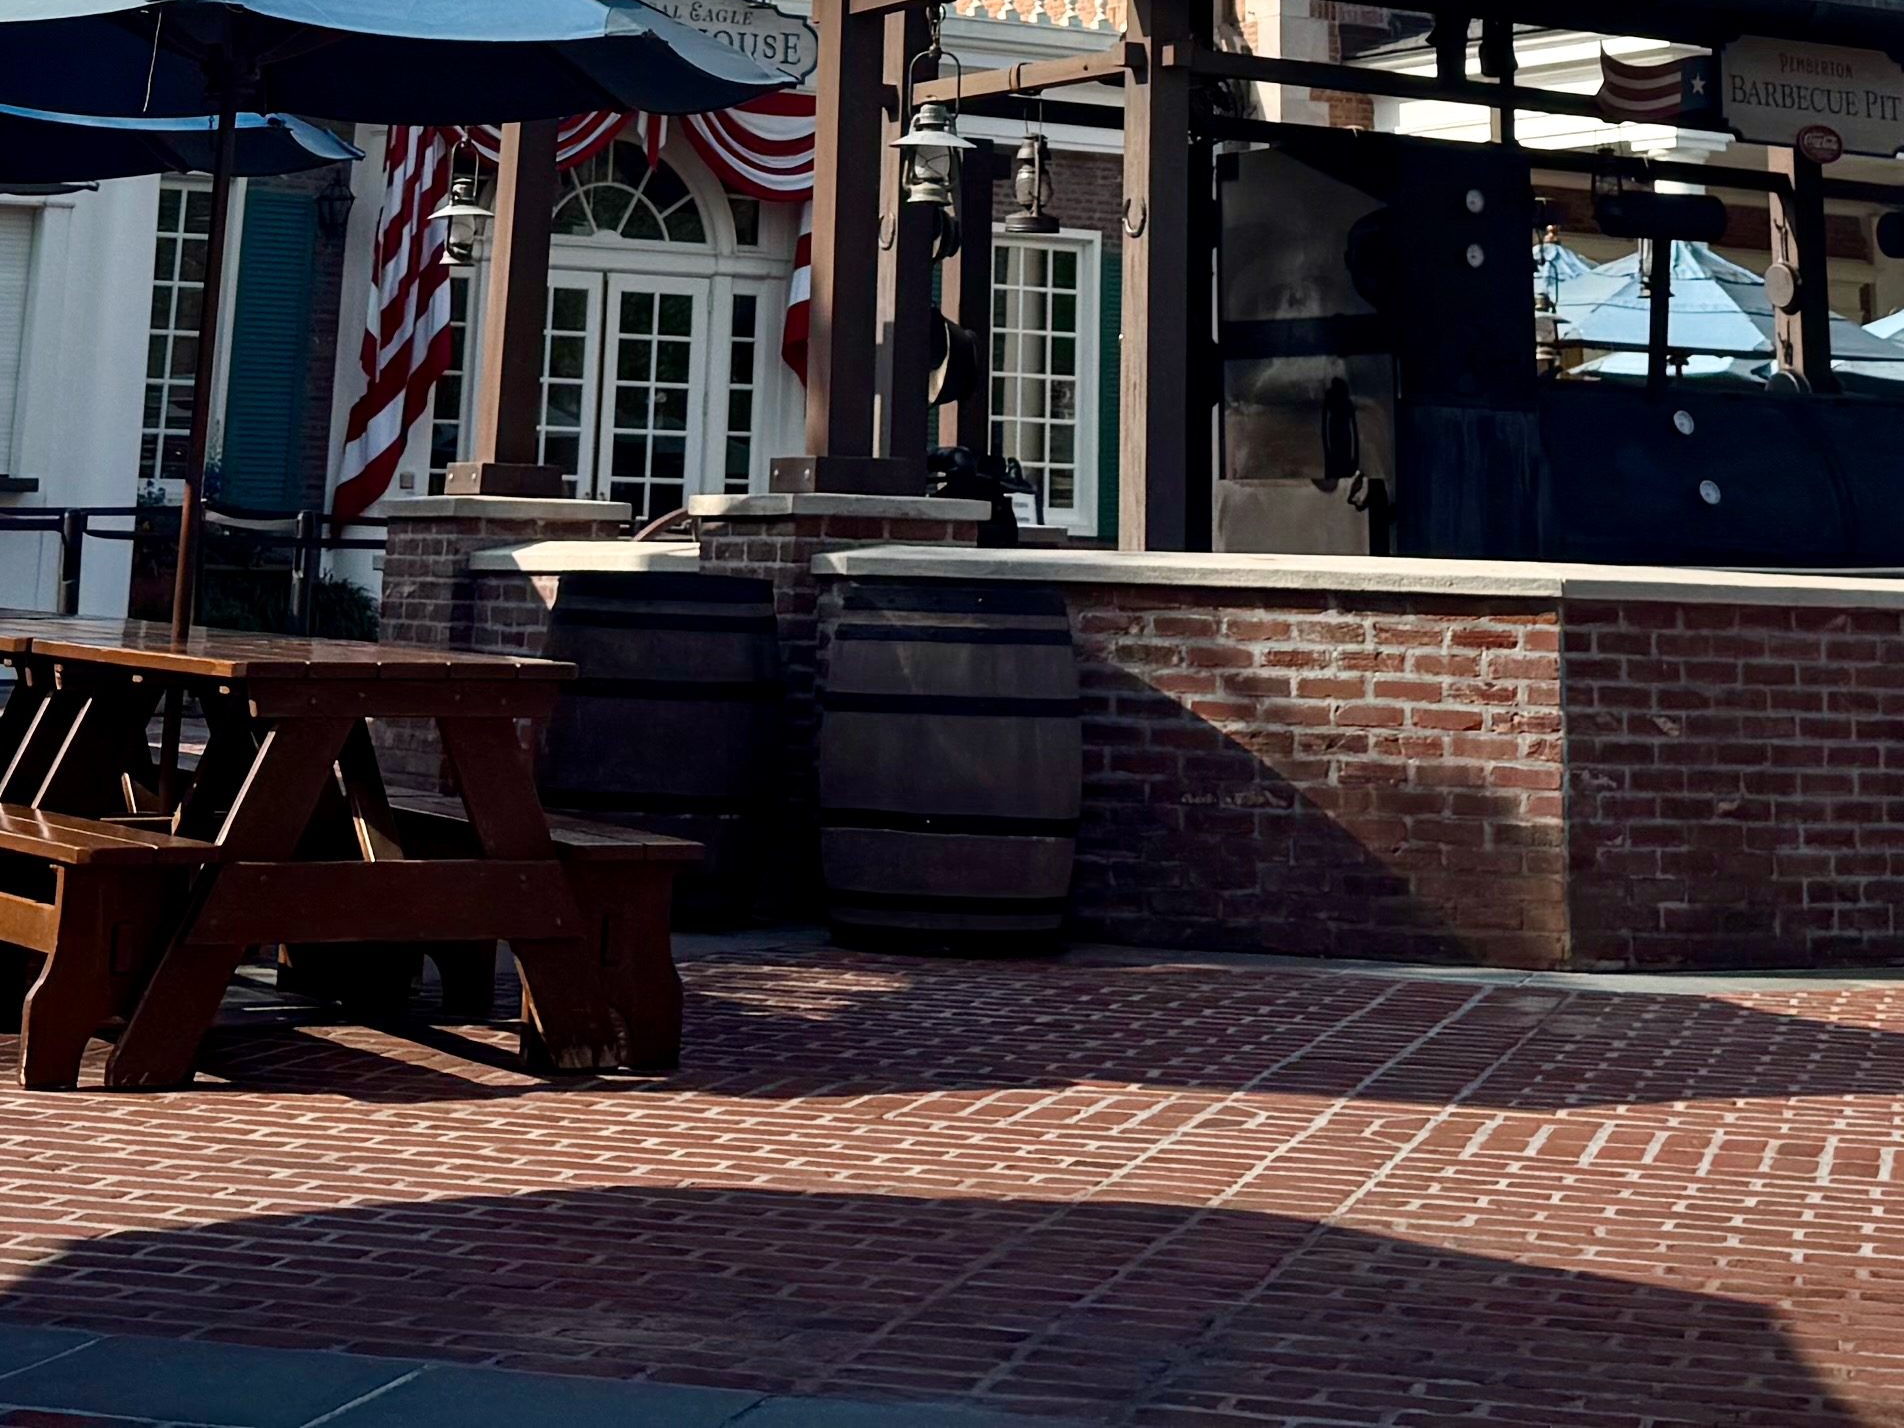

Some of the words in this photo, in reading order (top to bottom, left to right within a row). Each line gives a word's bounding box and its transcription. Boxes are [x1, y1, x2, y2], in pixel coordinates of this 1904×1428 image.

[689, 1, 753, 25] EAGLE
[1729, 74, 1859, 117] BARBECUE
[1864, 90, 1902, 121] PIT
